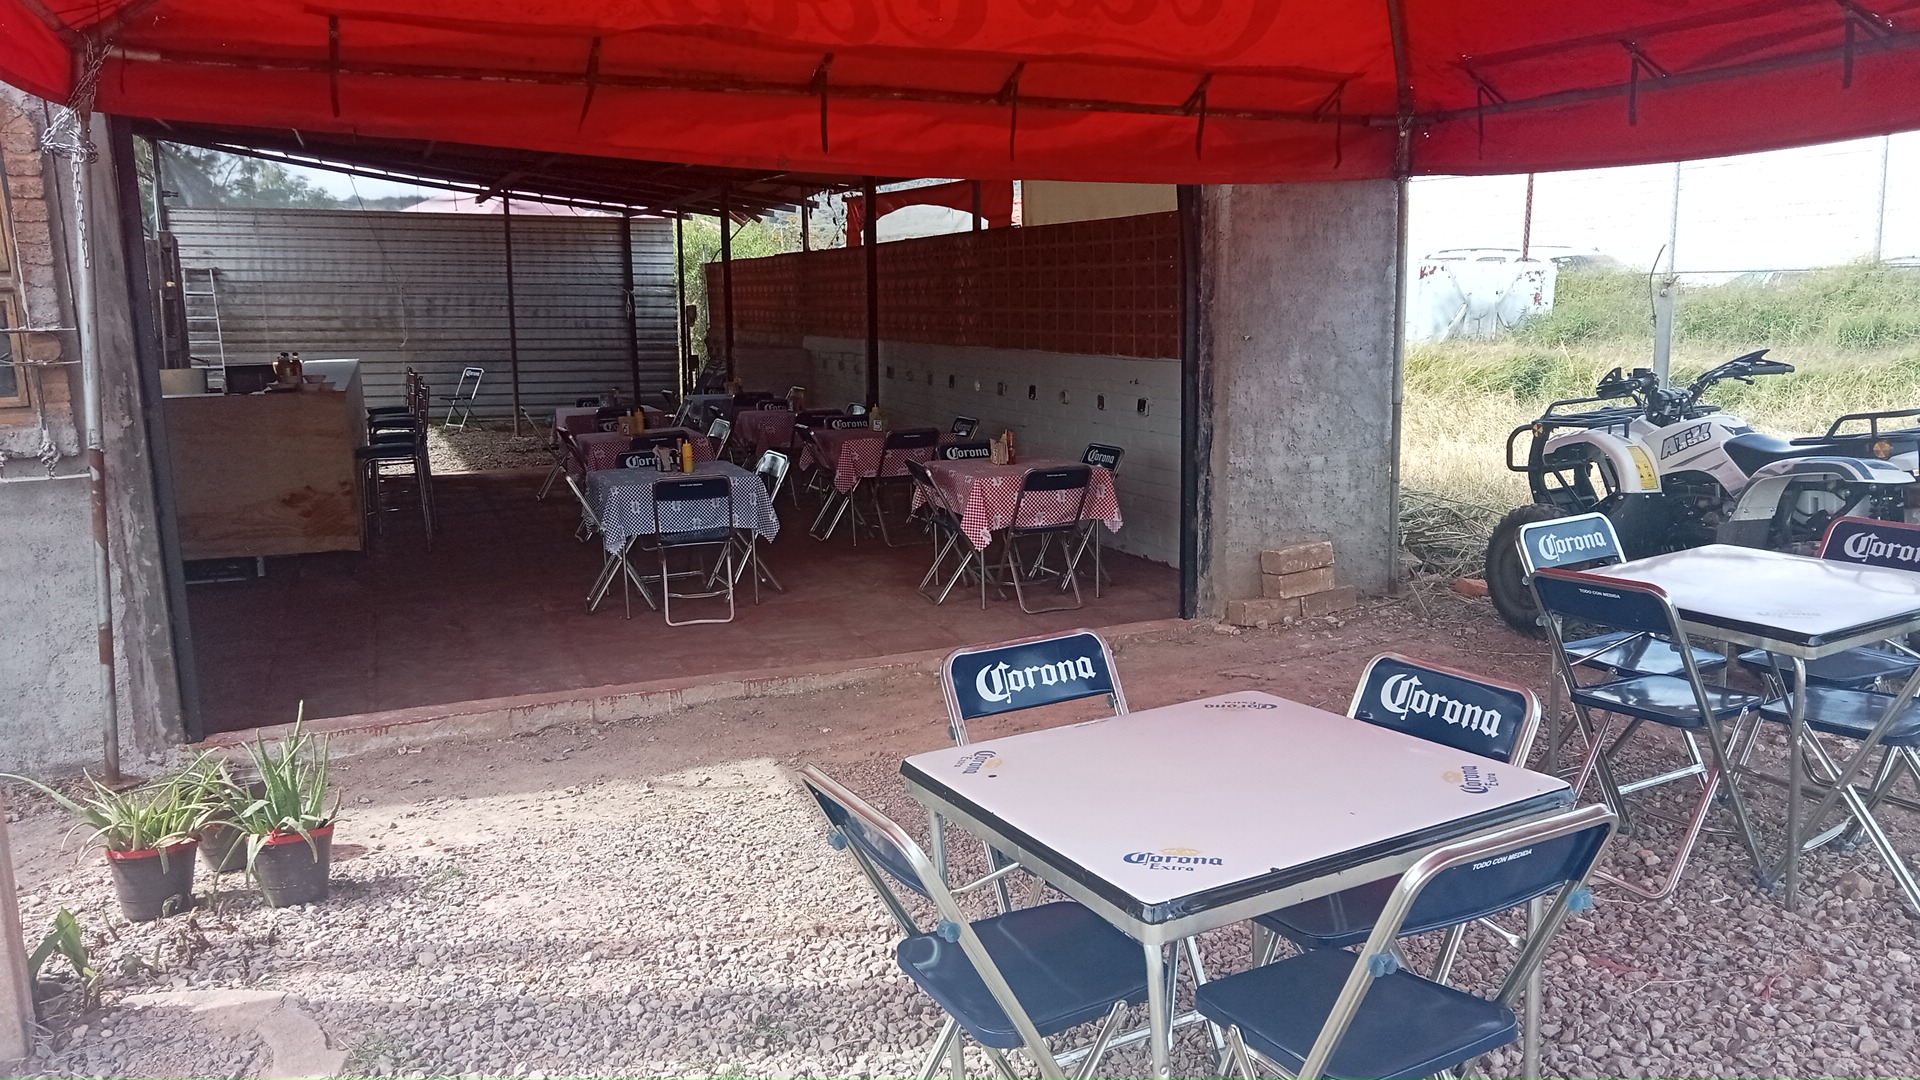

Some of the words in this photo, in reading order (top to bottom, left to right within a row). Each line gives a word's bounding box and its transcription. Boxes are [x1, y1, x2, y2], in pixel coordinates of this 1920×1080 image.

[831, 419, 868, 430] Corona
[946, 447, 989, 460] Corona
[1087, 449, 1115, 464] Corona
[1538, 531, 1607, 562] Corona
[976, 656, 1097, 704] Corona
[1380, 673, 1502, 738] Corona
[962, 750, 997, 774] Corona
[1460, 765, 1489, 794] Corona
[1123, 852, 1223, 866] Corona
[1149, 863, 1194, 872] Extra
[1473, 860, 1492, 871] TODO
[1492, 856, 1508, 866] CON
[1508, 849, 1533, 862] MEDIDA
